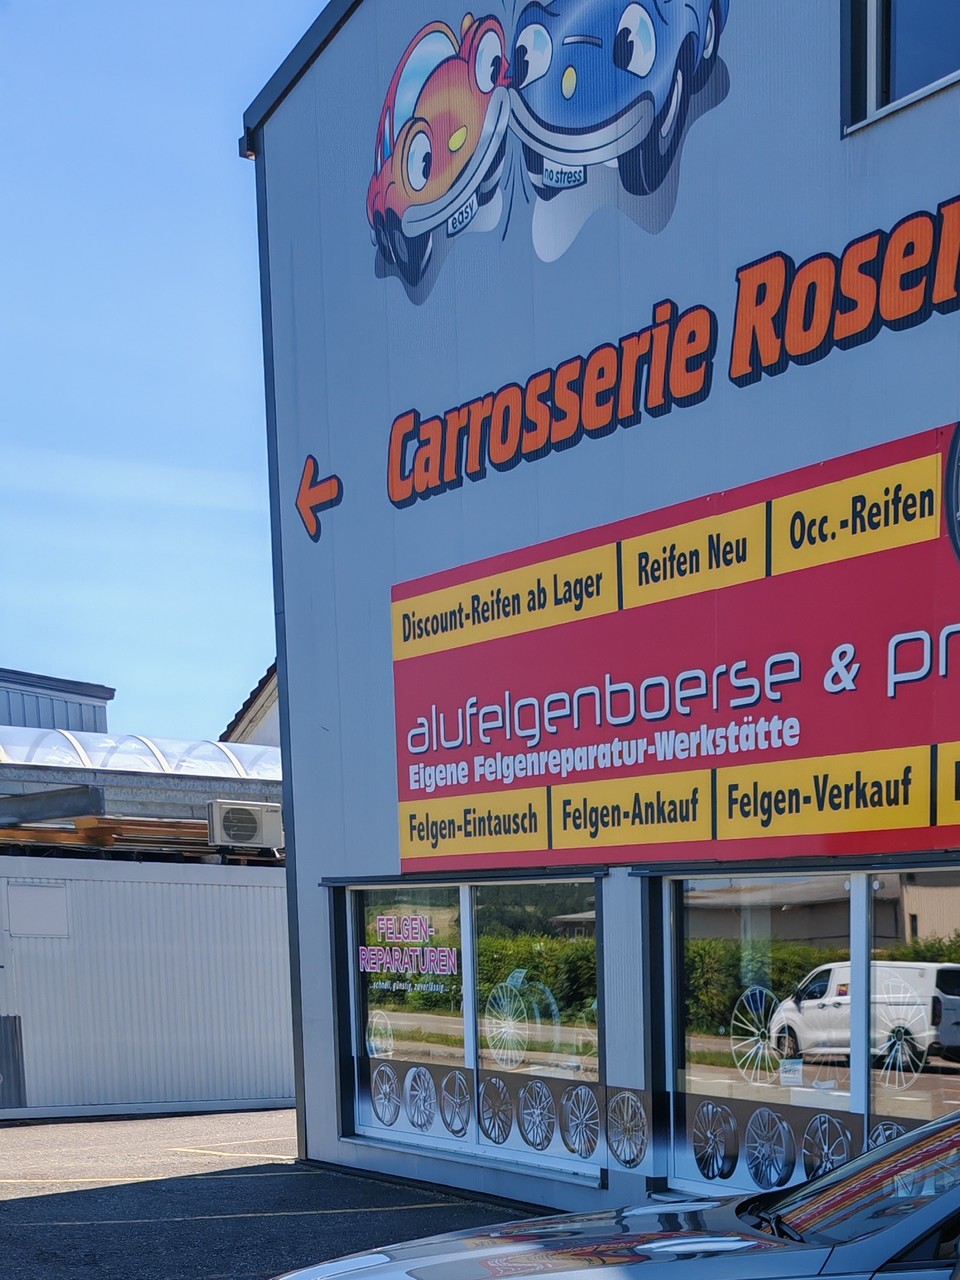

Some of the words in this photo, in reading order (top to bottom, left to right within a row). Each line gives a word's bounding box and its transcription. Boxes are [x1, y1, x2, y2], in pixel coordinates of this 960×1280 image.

[545, 168, 554, 179] no
[555, 167, 582, 184] stress
[451, 199, 474, 230] easy
[387, 298, 717, 508] Carrosserie
[790, 484, 934, 549] Occ.-Reifen
[637, 543, 700, 587] Reifen
[708, 532, 747, 570] Neu
[402, 582, 522, 643] Discount-Reifen
[527, 578, 547, 613] ab
[553, 571, 603, 612] Lager
[407, 651, 801, 754] alufelgenboerse
[823, 643, 861, 693] &
[409, 758, 469, 792] Eigene
[474, 715, 801, 785] Felgenreparatur-Werkstätte
[562, 787, 699, 838] Felgen-Ankauf
[727, 766, 912, 827] Felgen-Verkauf
[409, 803, 538, 848] Felgen-Eintausch
[377, 916, 435, 942] FELGEN-
[360, 947, 457, 975] REPARATUREN
